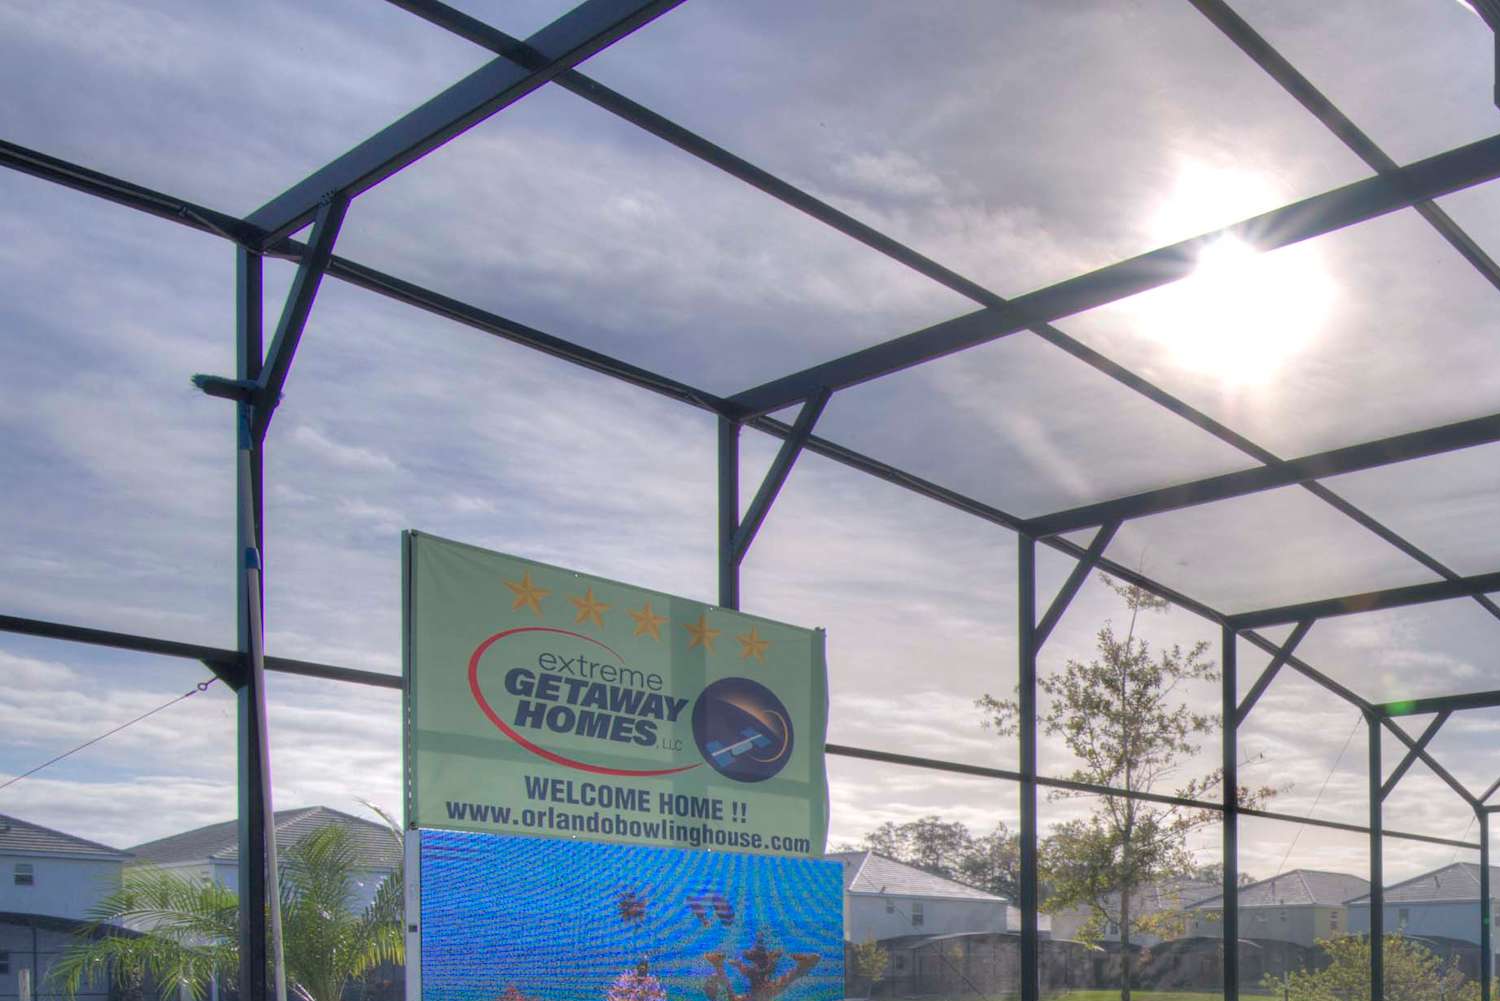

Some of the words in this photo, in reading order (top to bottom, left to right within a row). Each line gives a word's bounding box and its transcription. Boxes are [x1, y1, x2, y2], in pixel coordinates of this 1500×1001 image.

[504, 667, 689, 722] GETAWAY
[538, 652, 663, 691] extreme
[662, 738, 683, 751] LLC
[524, 775, 651, 813] WELCOME
[659, 793, 724, 821] HOME
[731, 803, 748, 823] !!
[446, 800, 811, 854] www.orlandobowlinghouse.com
